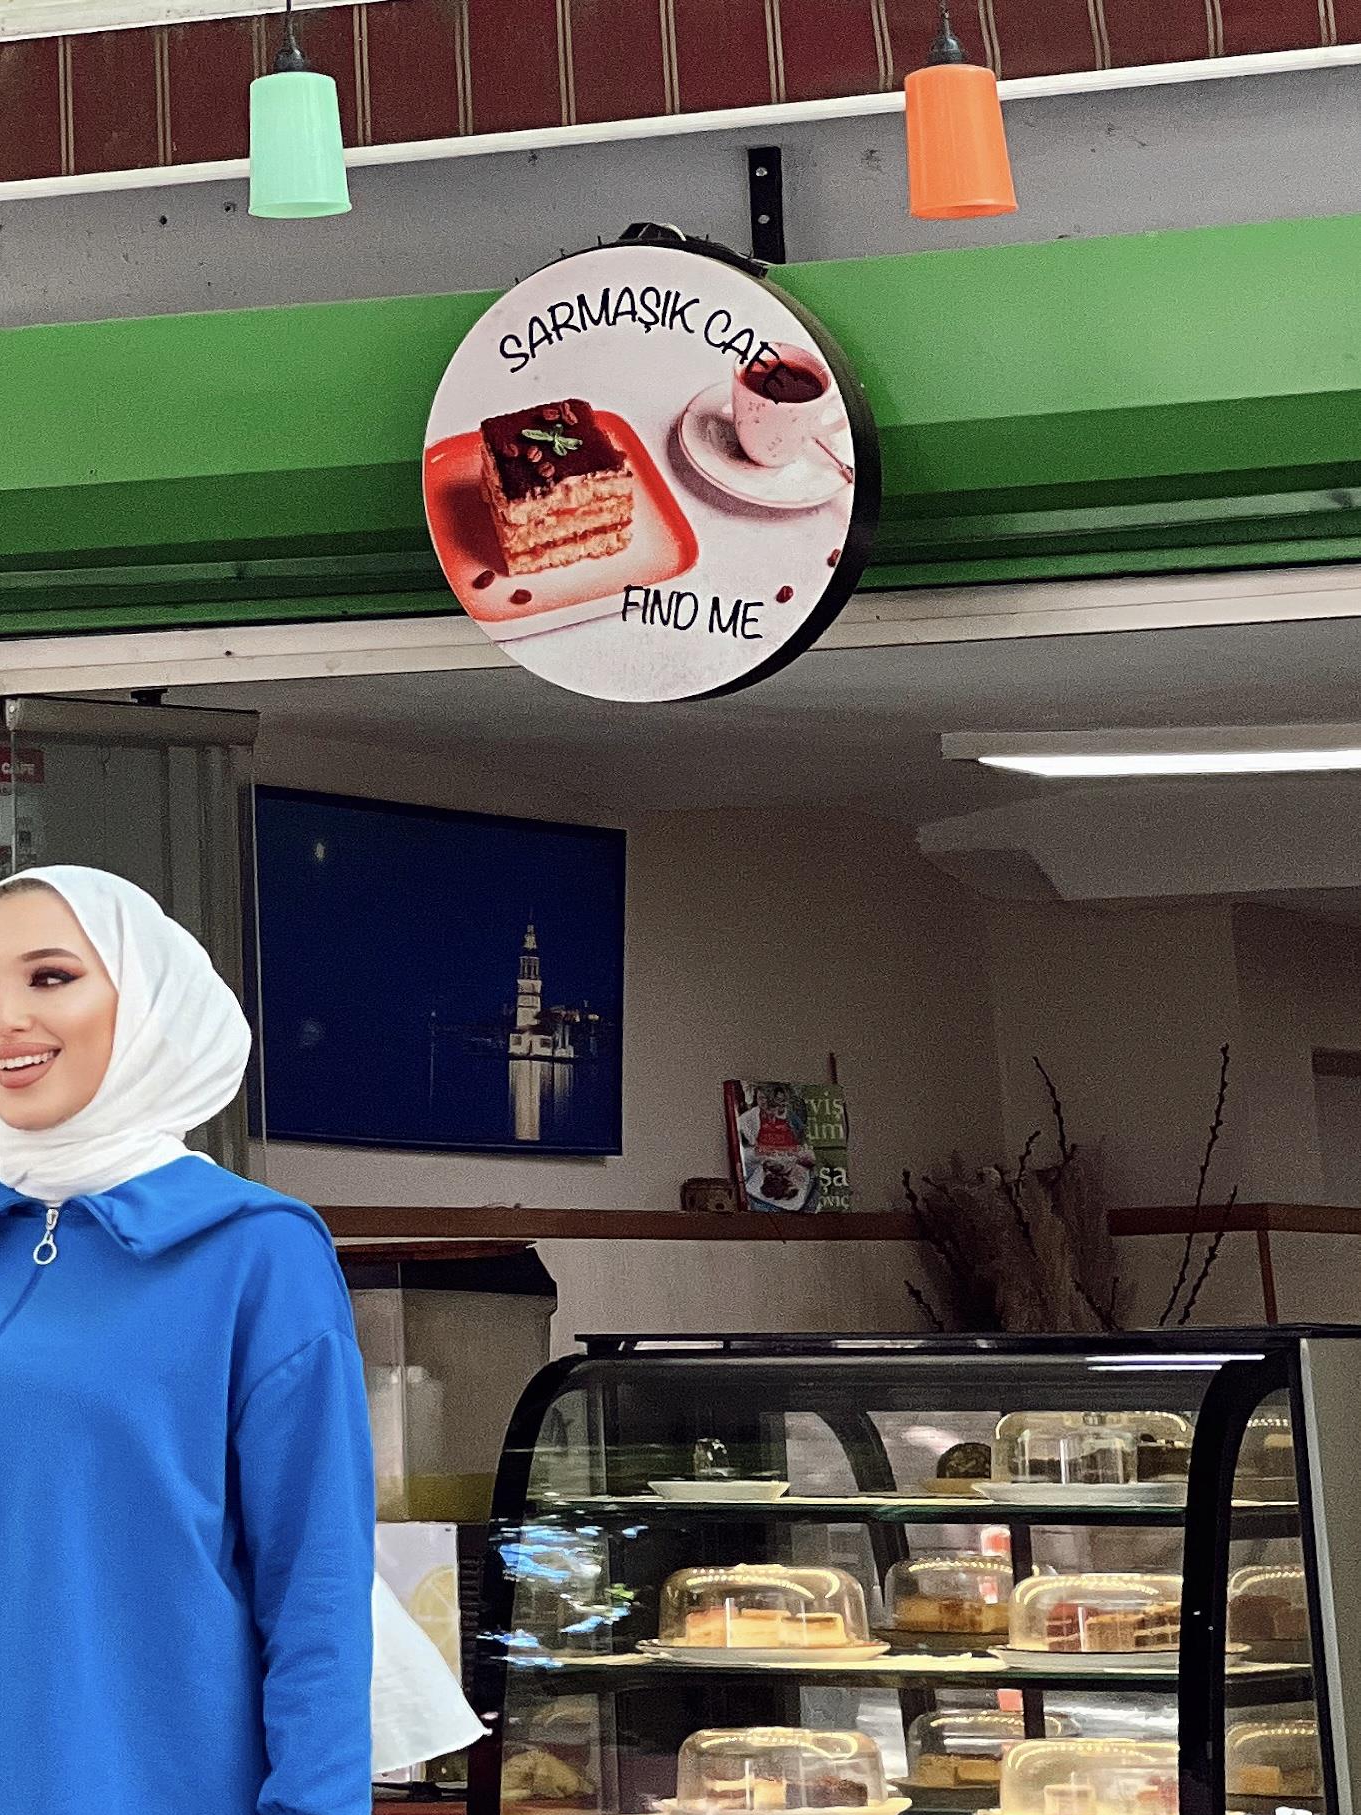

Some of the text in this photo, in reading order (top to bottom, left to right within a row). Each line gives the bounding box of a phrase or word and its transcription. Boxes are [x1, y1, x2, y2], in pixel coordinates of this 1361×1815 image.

[499, 286, 787, 404] SARMAŞIK CAFE
[622, 584, 764, 639] FIND ME
